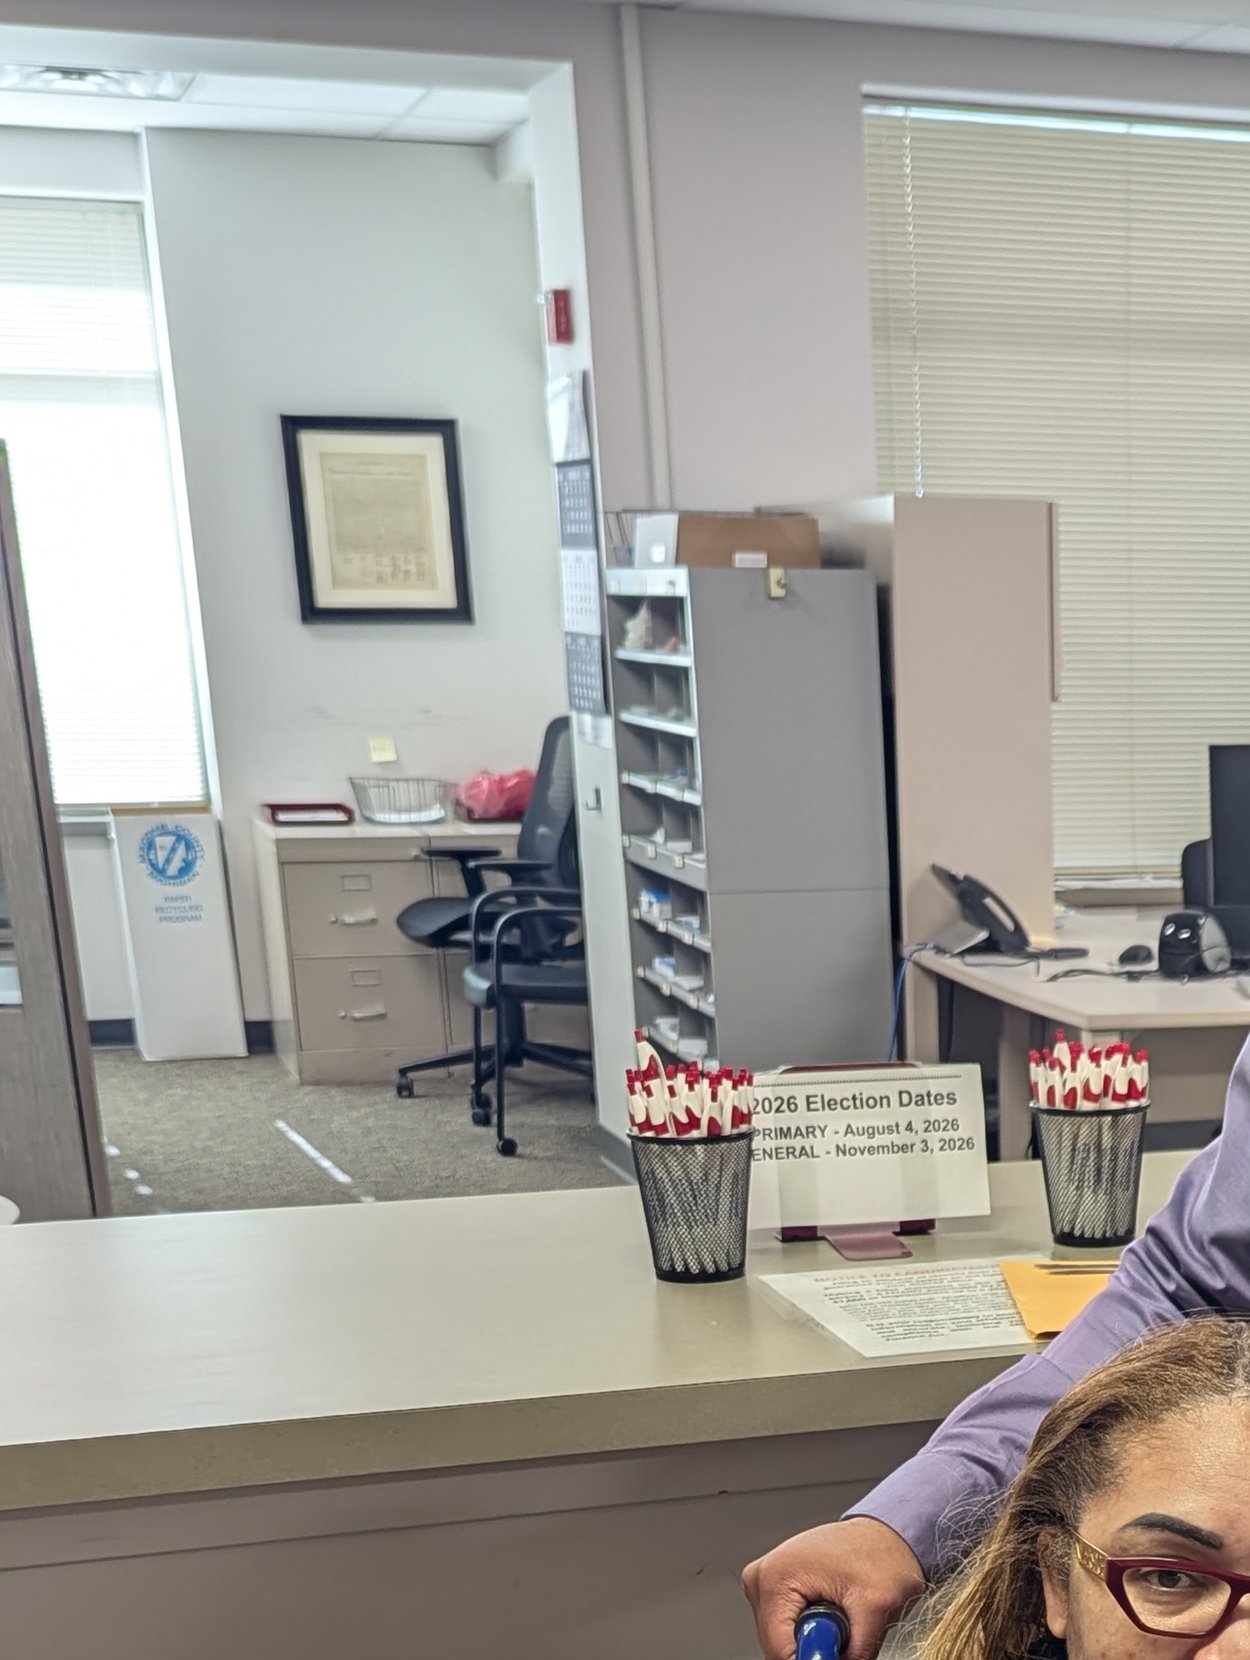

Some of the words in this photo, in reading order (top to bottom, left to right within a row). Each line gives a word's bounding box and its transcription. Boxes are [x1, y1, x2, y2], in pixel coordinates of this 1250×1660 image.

[752, 1096, 799, 1115] 2026
[806, 1092, 891, 1112] Election
[898, 1089, 958, 1108] Dates
[844, 1122, 901, 1140] August
[905, 1121, 919, 1137] 4,
[923, 1118, 960, 1133] 2026
[752, 1145, 820, 1162] ENERAL
[836, 1141, 915, 1158] November
[920, 1140, 934, 1155] 3,
[938, 1136, 975, 1152] 2026
